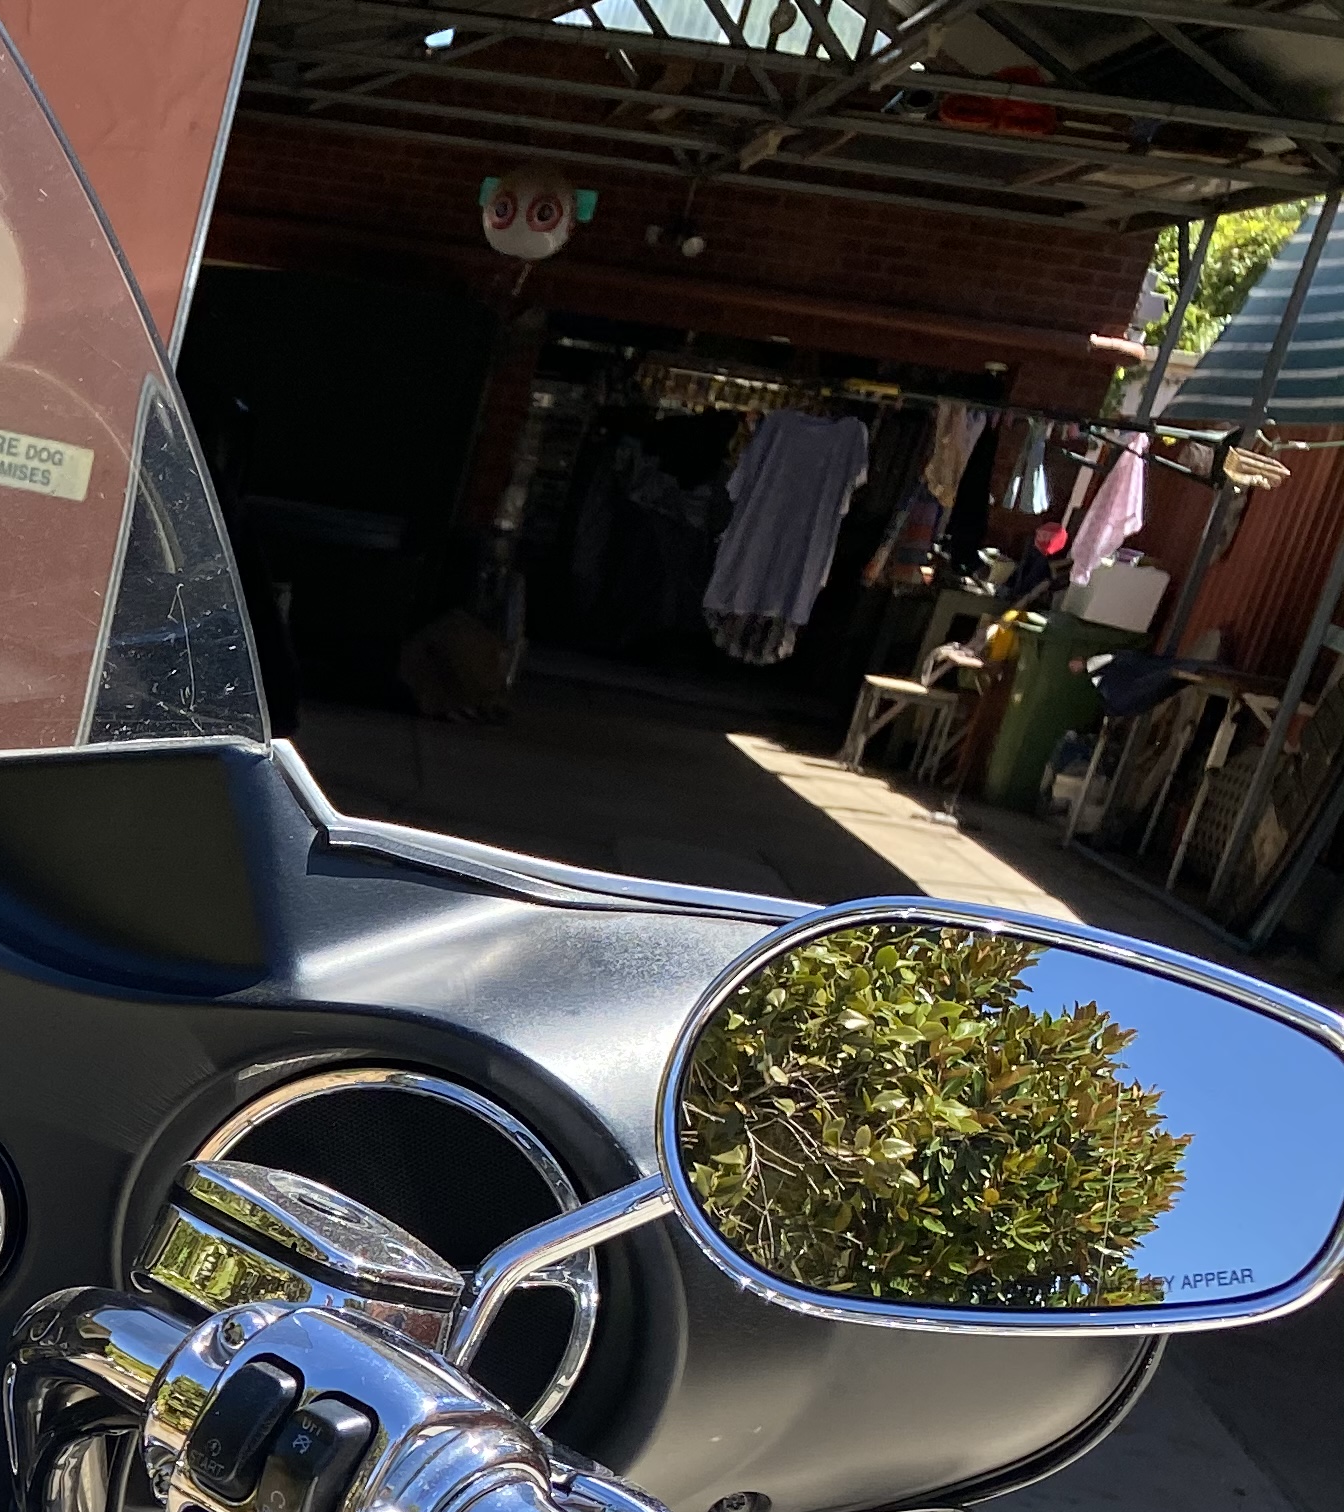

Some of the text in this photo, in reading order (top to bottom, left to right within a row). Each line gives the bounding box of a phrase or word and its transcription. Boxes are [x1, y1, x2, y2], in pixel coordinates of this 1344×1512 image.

[25, 444, 64, 466] DOG
[1180, 1268, 1255, 1290] APPEAR
[190, 1451, 225, 1477] START
